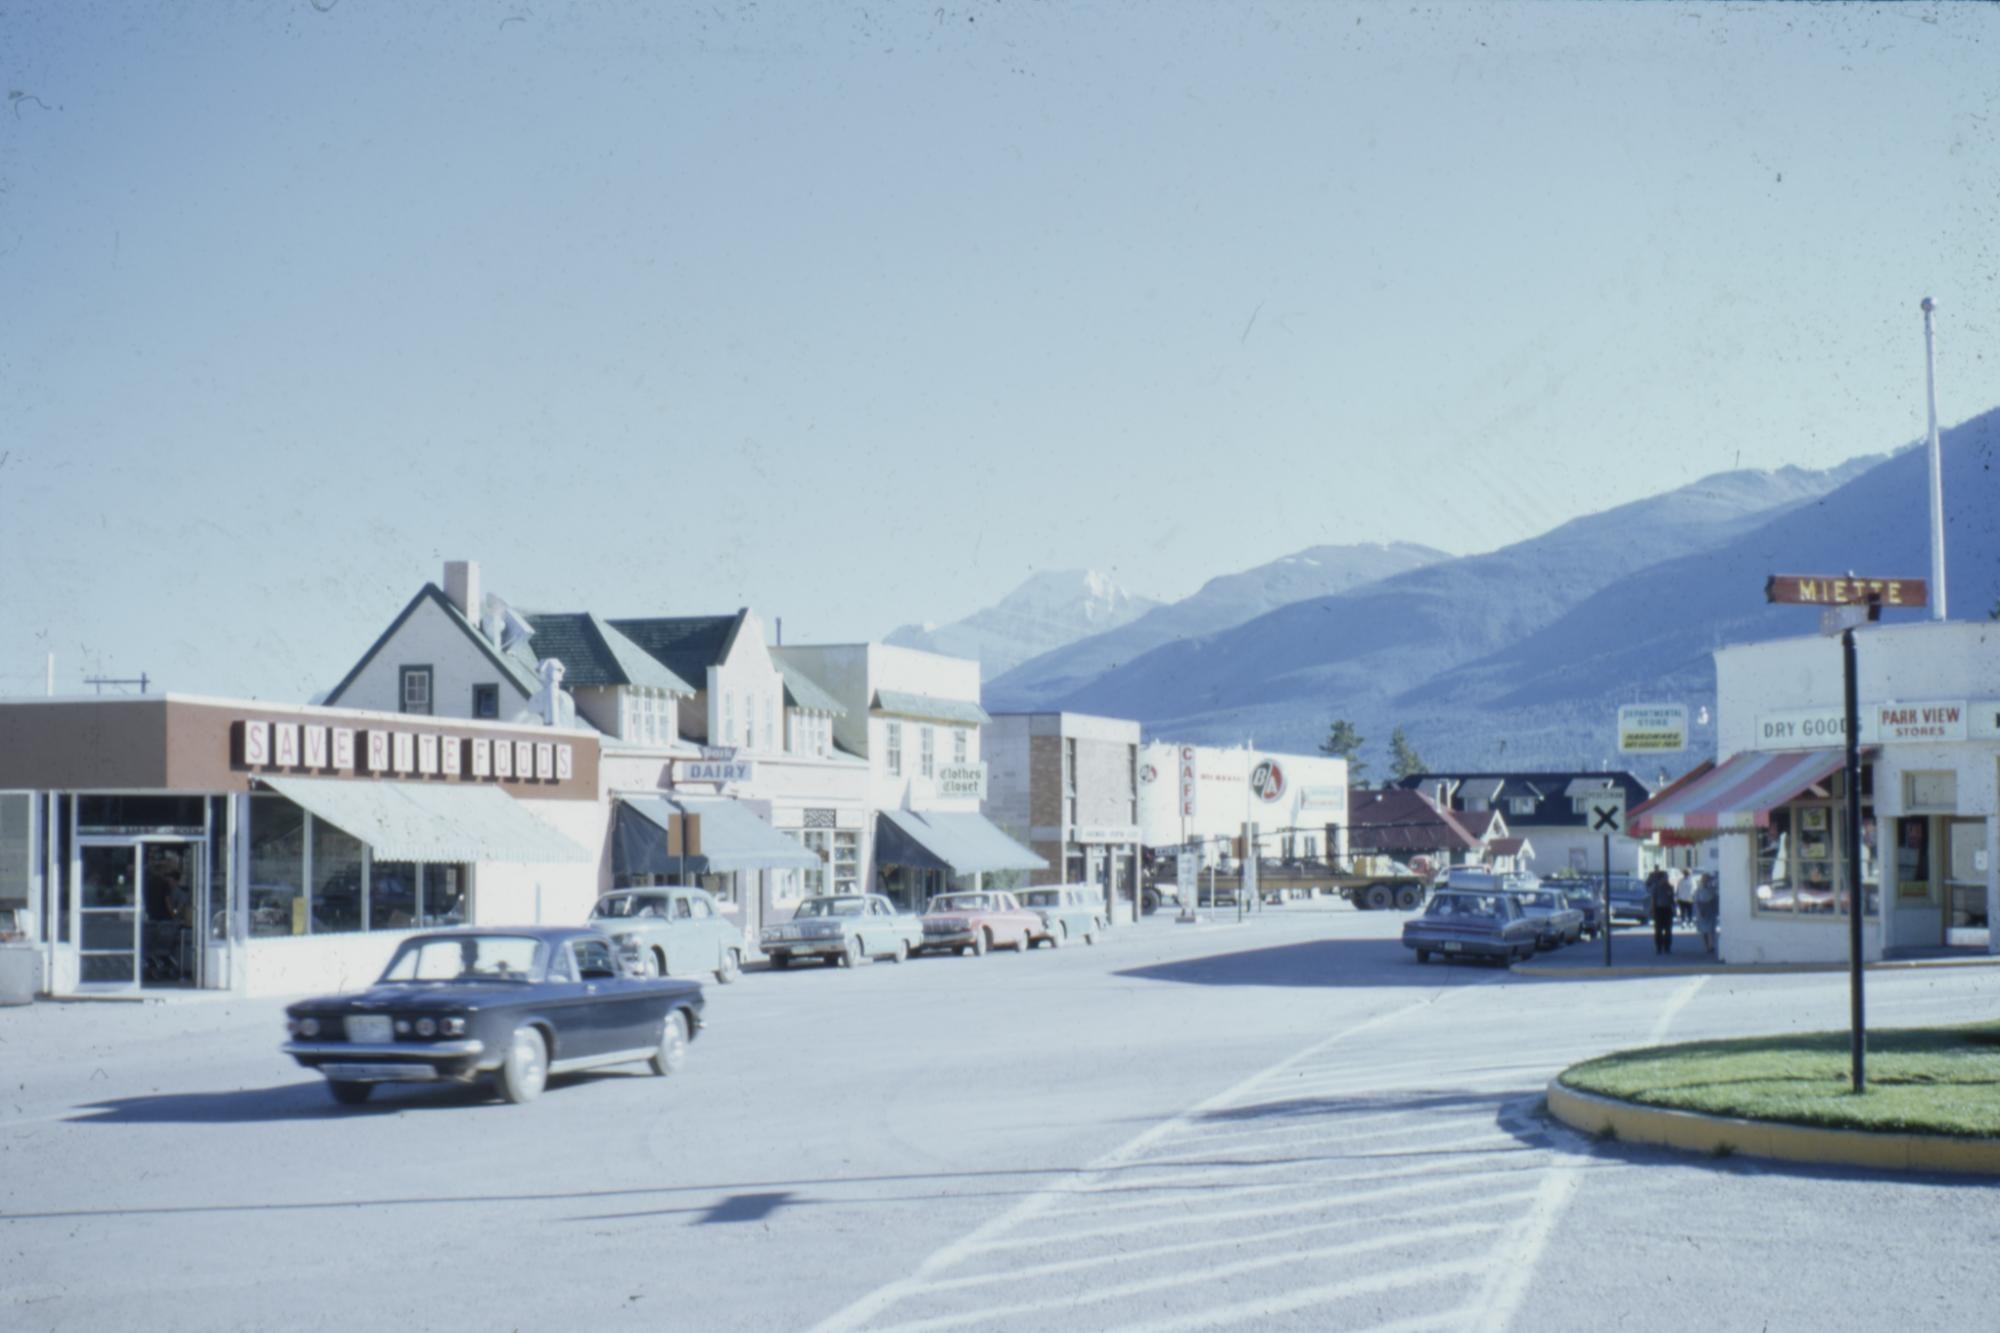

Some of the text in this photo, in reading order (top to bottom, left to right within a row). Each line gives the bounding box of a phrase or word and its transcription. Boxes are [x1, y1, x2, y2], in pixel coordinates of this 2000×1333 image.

[1799, 579, 1903, 605] MIETTE
[1882, 707, 1960, 725] PARK VIEW
[1764, 721, 1797, 738] DRY
[1895, 726, 1946, 737] STORES
[249, 722, 570, 777] SAVE RITE FOODS
[690, 764, 747, 779] DAIRY
[939, 767, 981, 780] Clothes
[942, 780, 978, 792] Closet
[1183, 746, 1194, 816] CAFE
